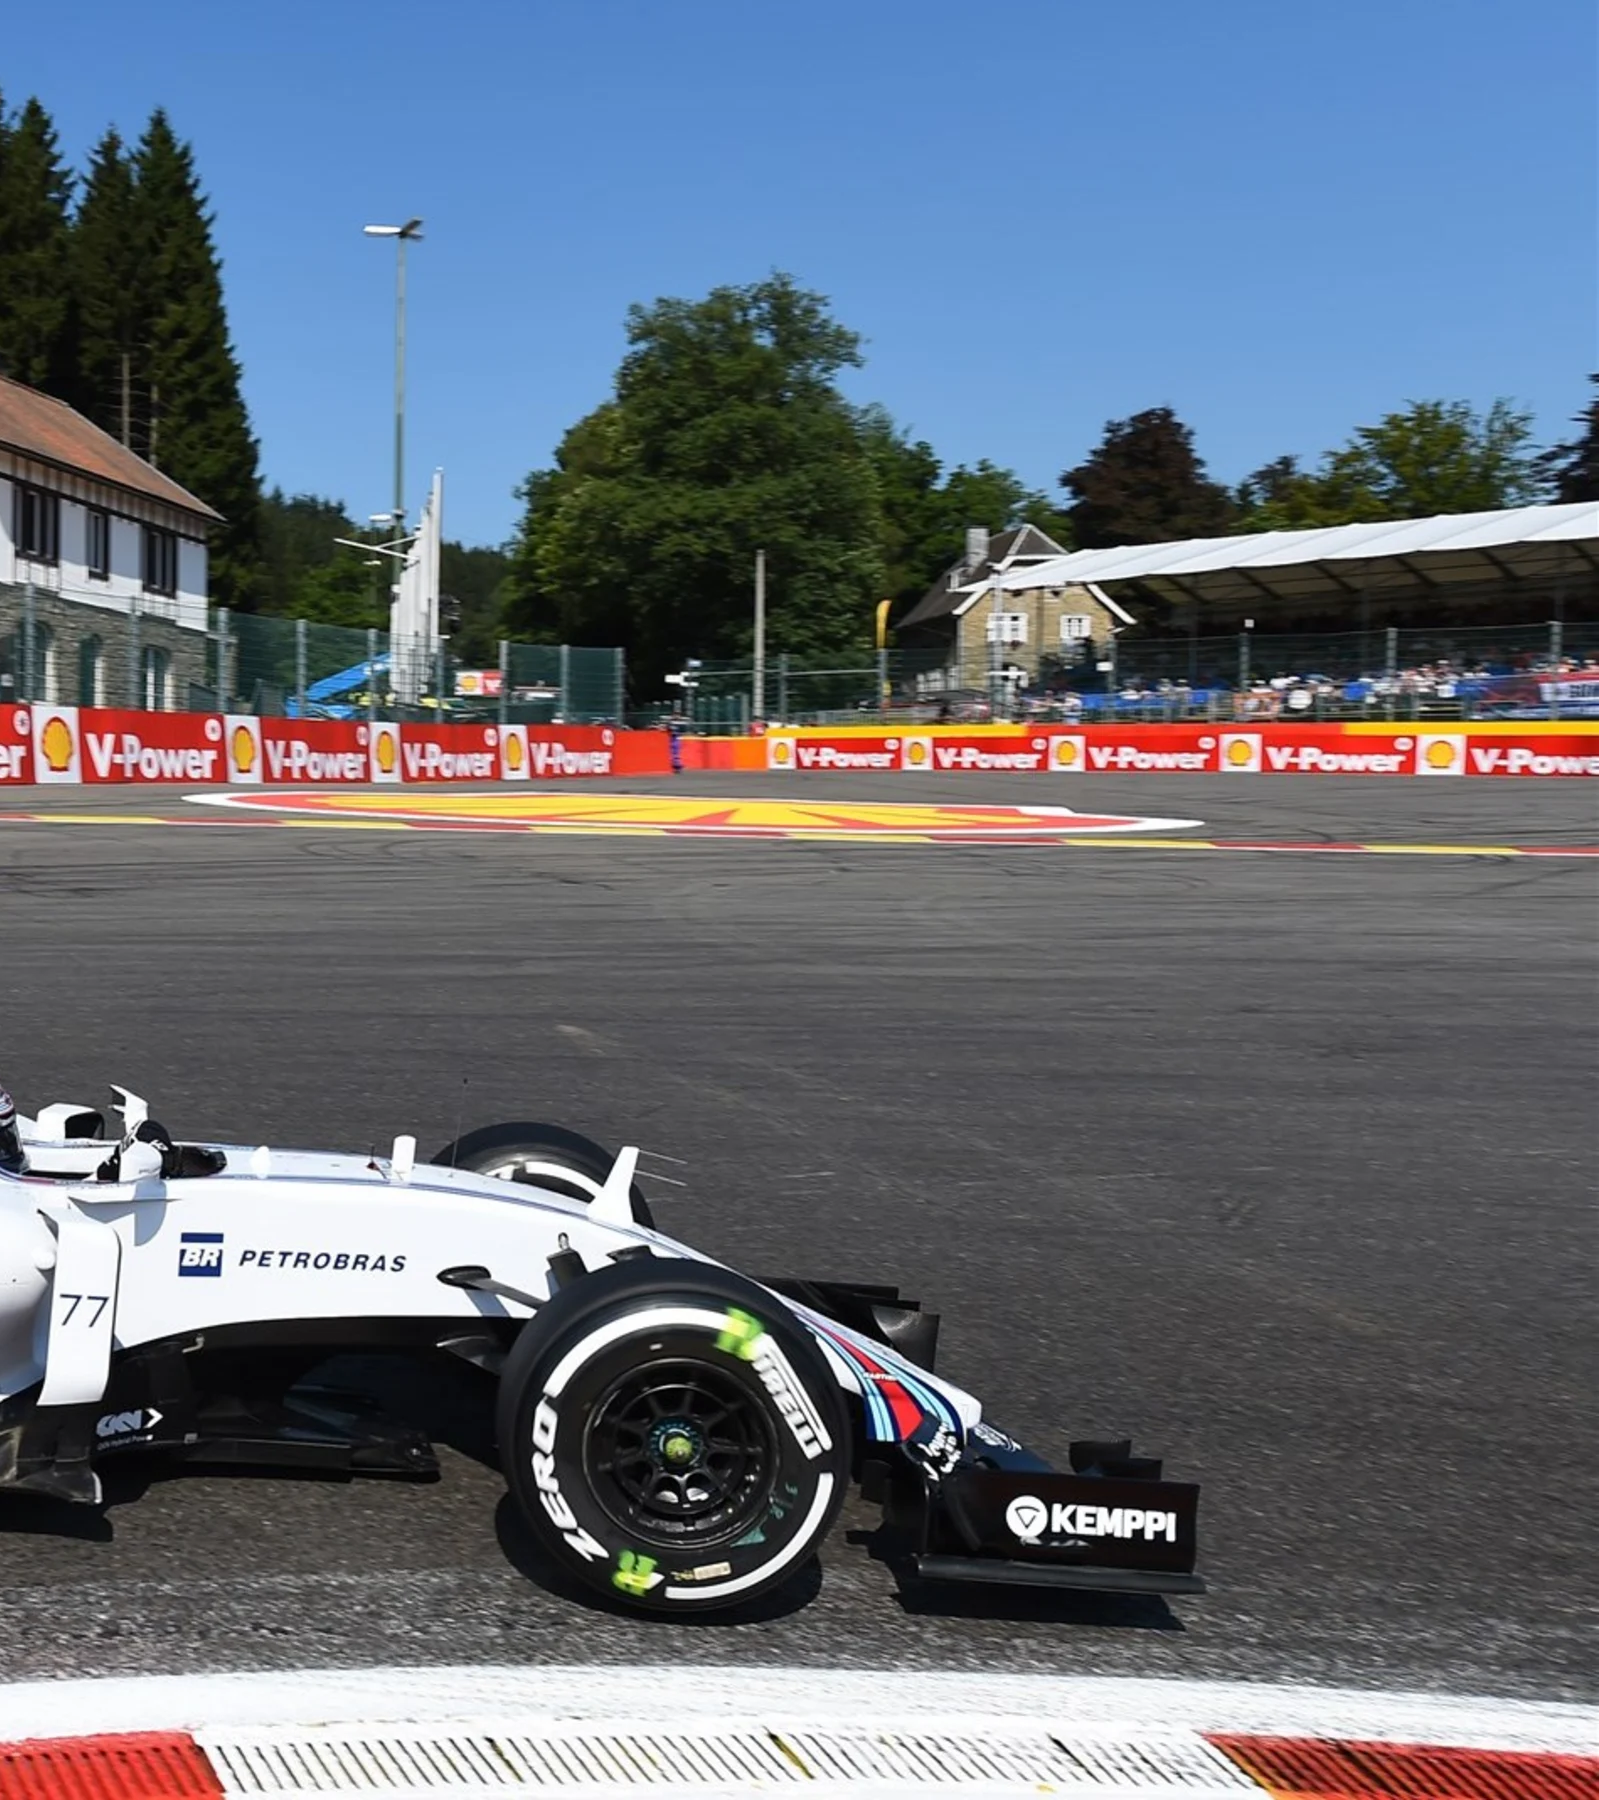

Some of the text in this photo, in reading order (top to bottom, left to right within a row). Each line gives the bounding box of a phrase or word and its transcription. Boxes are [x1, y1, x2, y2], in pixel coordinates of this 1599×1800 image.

[86, 733, 219, 780] V-Power
[262, 739, 368, 780] V-Power
[401, 742, 496, 779] V-Power
[530, 742, 613, 776] V-Power
[798, 748, 895, 769] V-Power
[935, 748, 1041, 770] V-Power
[1088, 746, 1210, 771] V-Power
[1266, 747, 1406, 772] V-Power
[180, 1247, 407, 1273] BR PETROBRAS
[59, 1293, 111, 1329] 77
[531, 1400, 611, 1563] ZERO
[1051, 1502, 1178, 1543] KEMPPI
